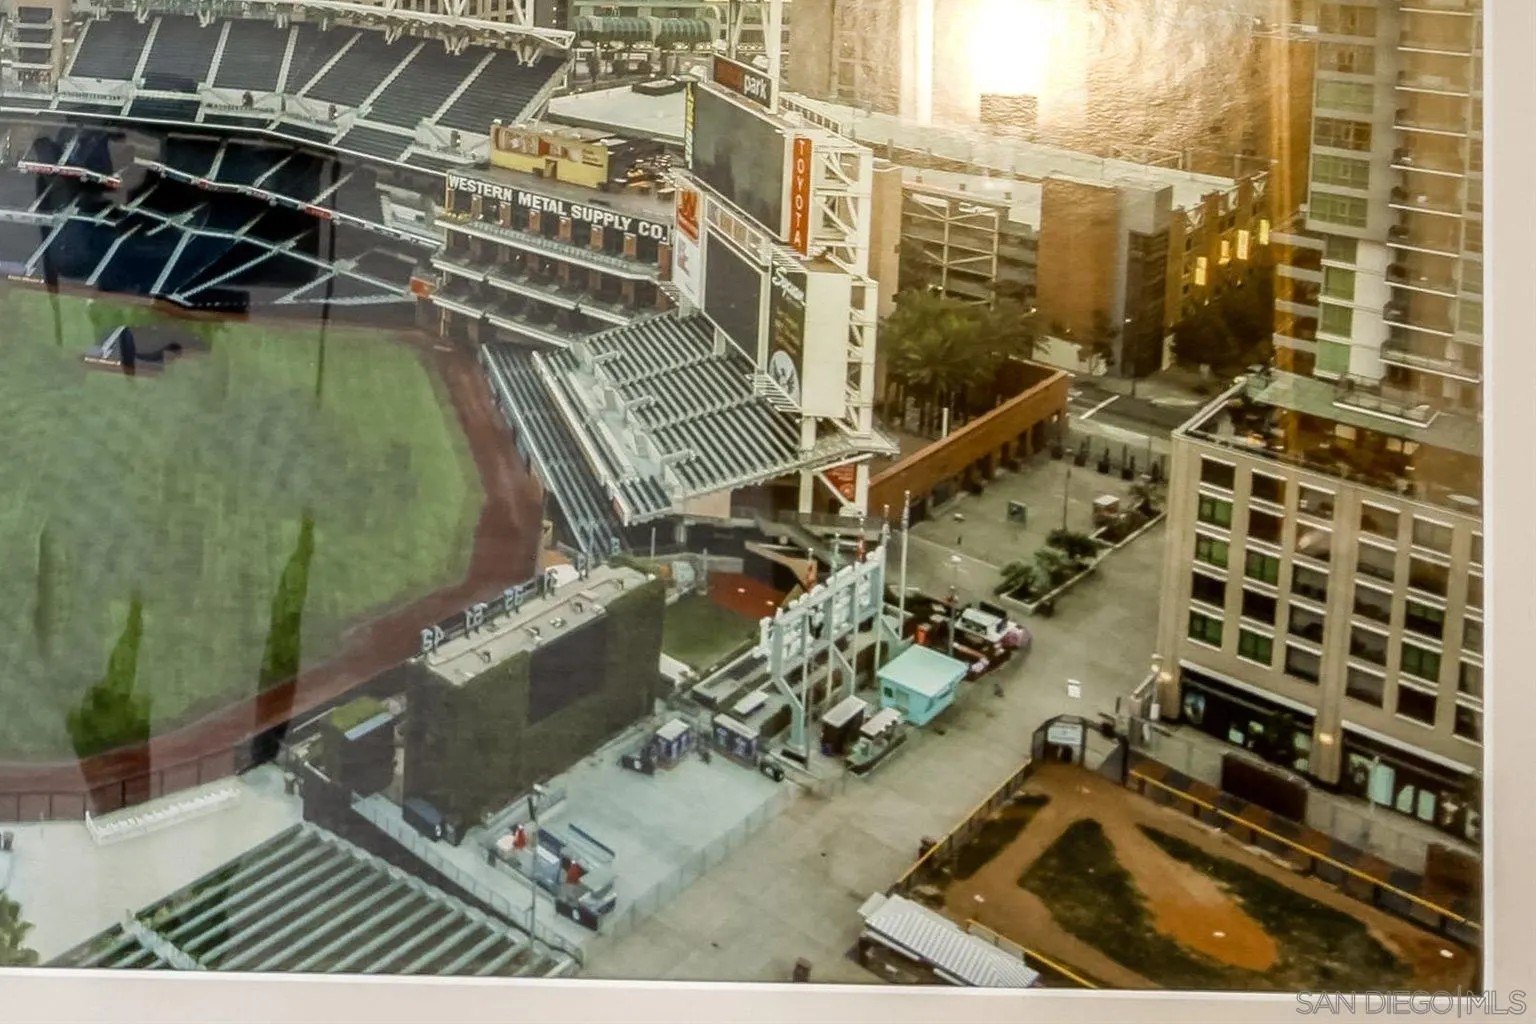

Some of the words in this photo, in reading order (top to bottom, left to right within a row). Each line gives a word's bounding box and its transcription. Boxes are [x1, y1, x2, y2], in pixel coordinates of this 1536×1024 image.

[744, 74, 767, 100] park
[448, 173, 513, 202] WESTERN
[518, 191, 568, 217] METAL
[571, 204, 633, 232] SUPPLY
[638, 221, 668, 241] CO.
[793, 139, 805, 246] TOYOTA
